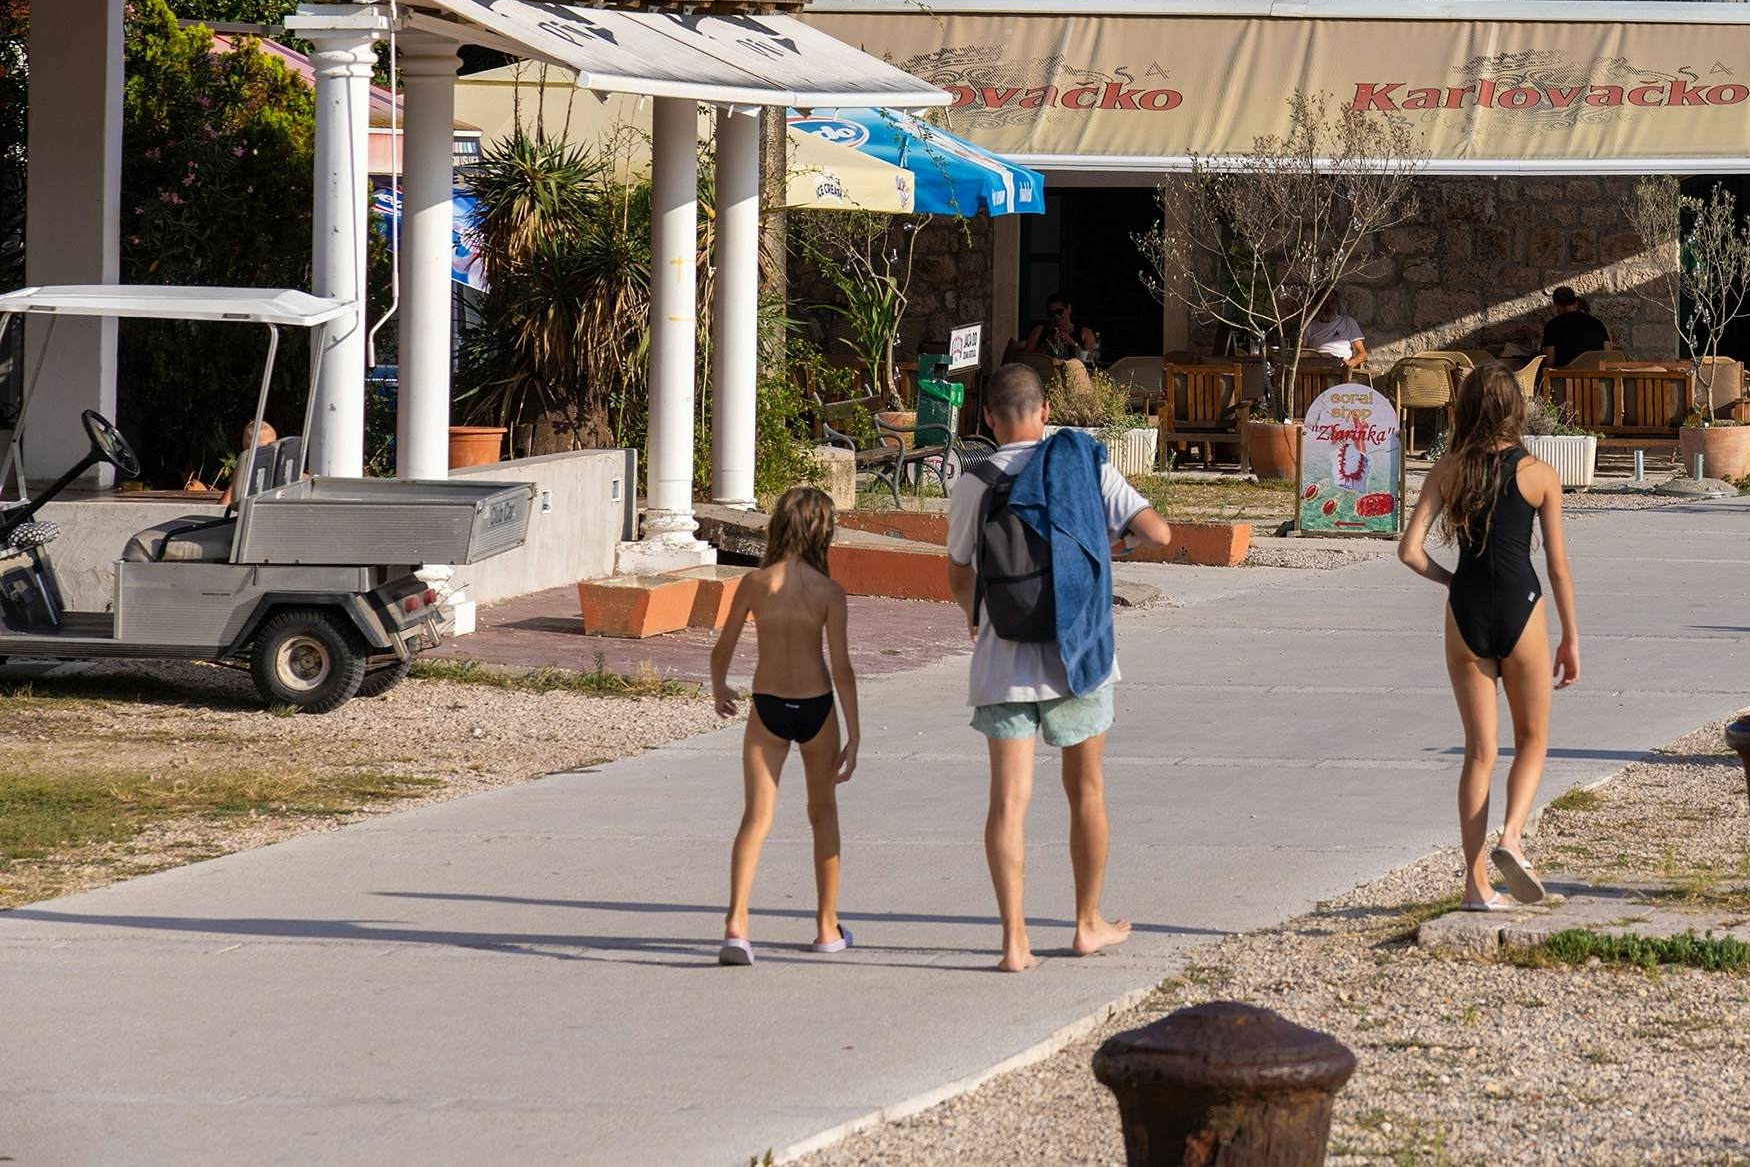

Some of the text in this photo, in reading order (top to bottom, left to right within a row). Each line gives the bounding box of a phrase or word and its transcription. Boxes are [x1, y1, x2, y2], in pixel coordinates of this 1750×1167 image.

[1351, 78, 1750, 112] Karlovačko
[815, 185, 825, 199] ICE
[1330, 391, 1373, 405] coral
[1330, 405, 1373, 422] shop
